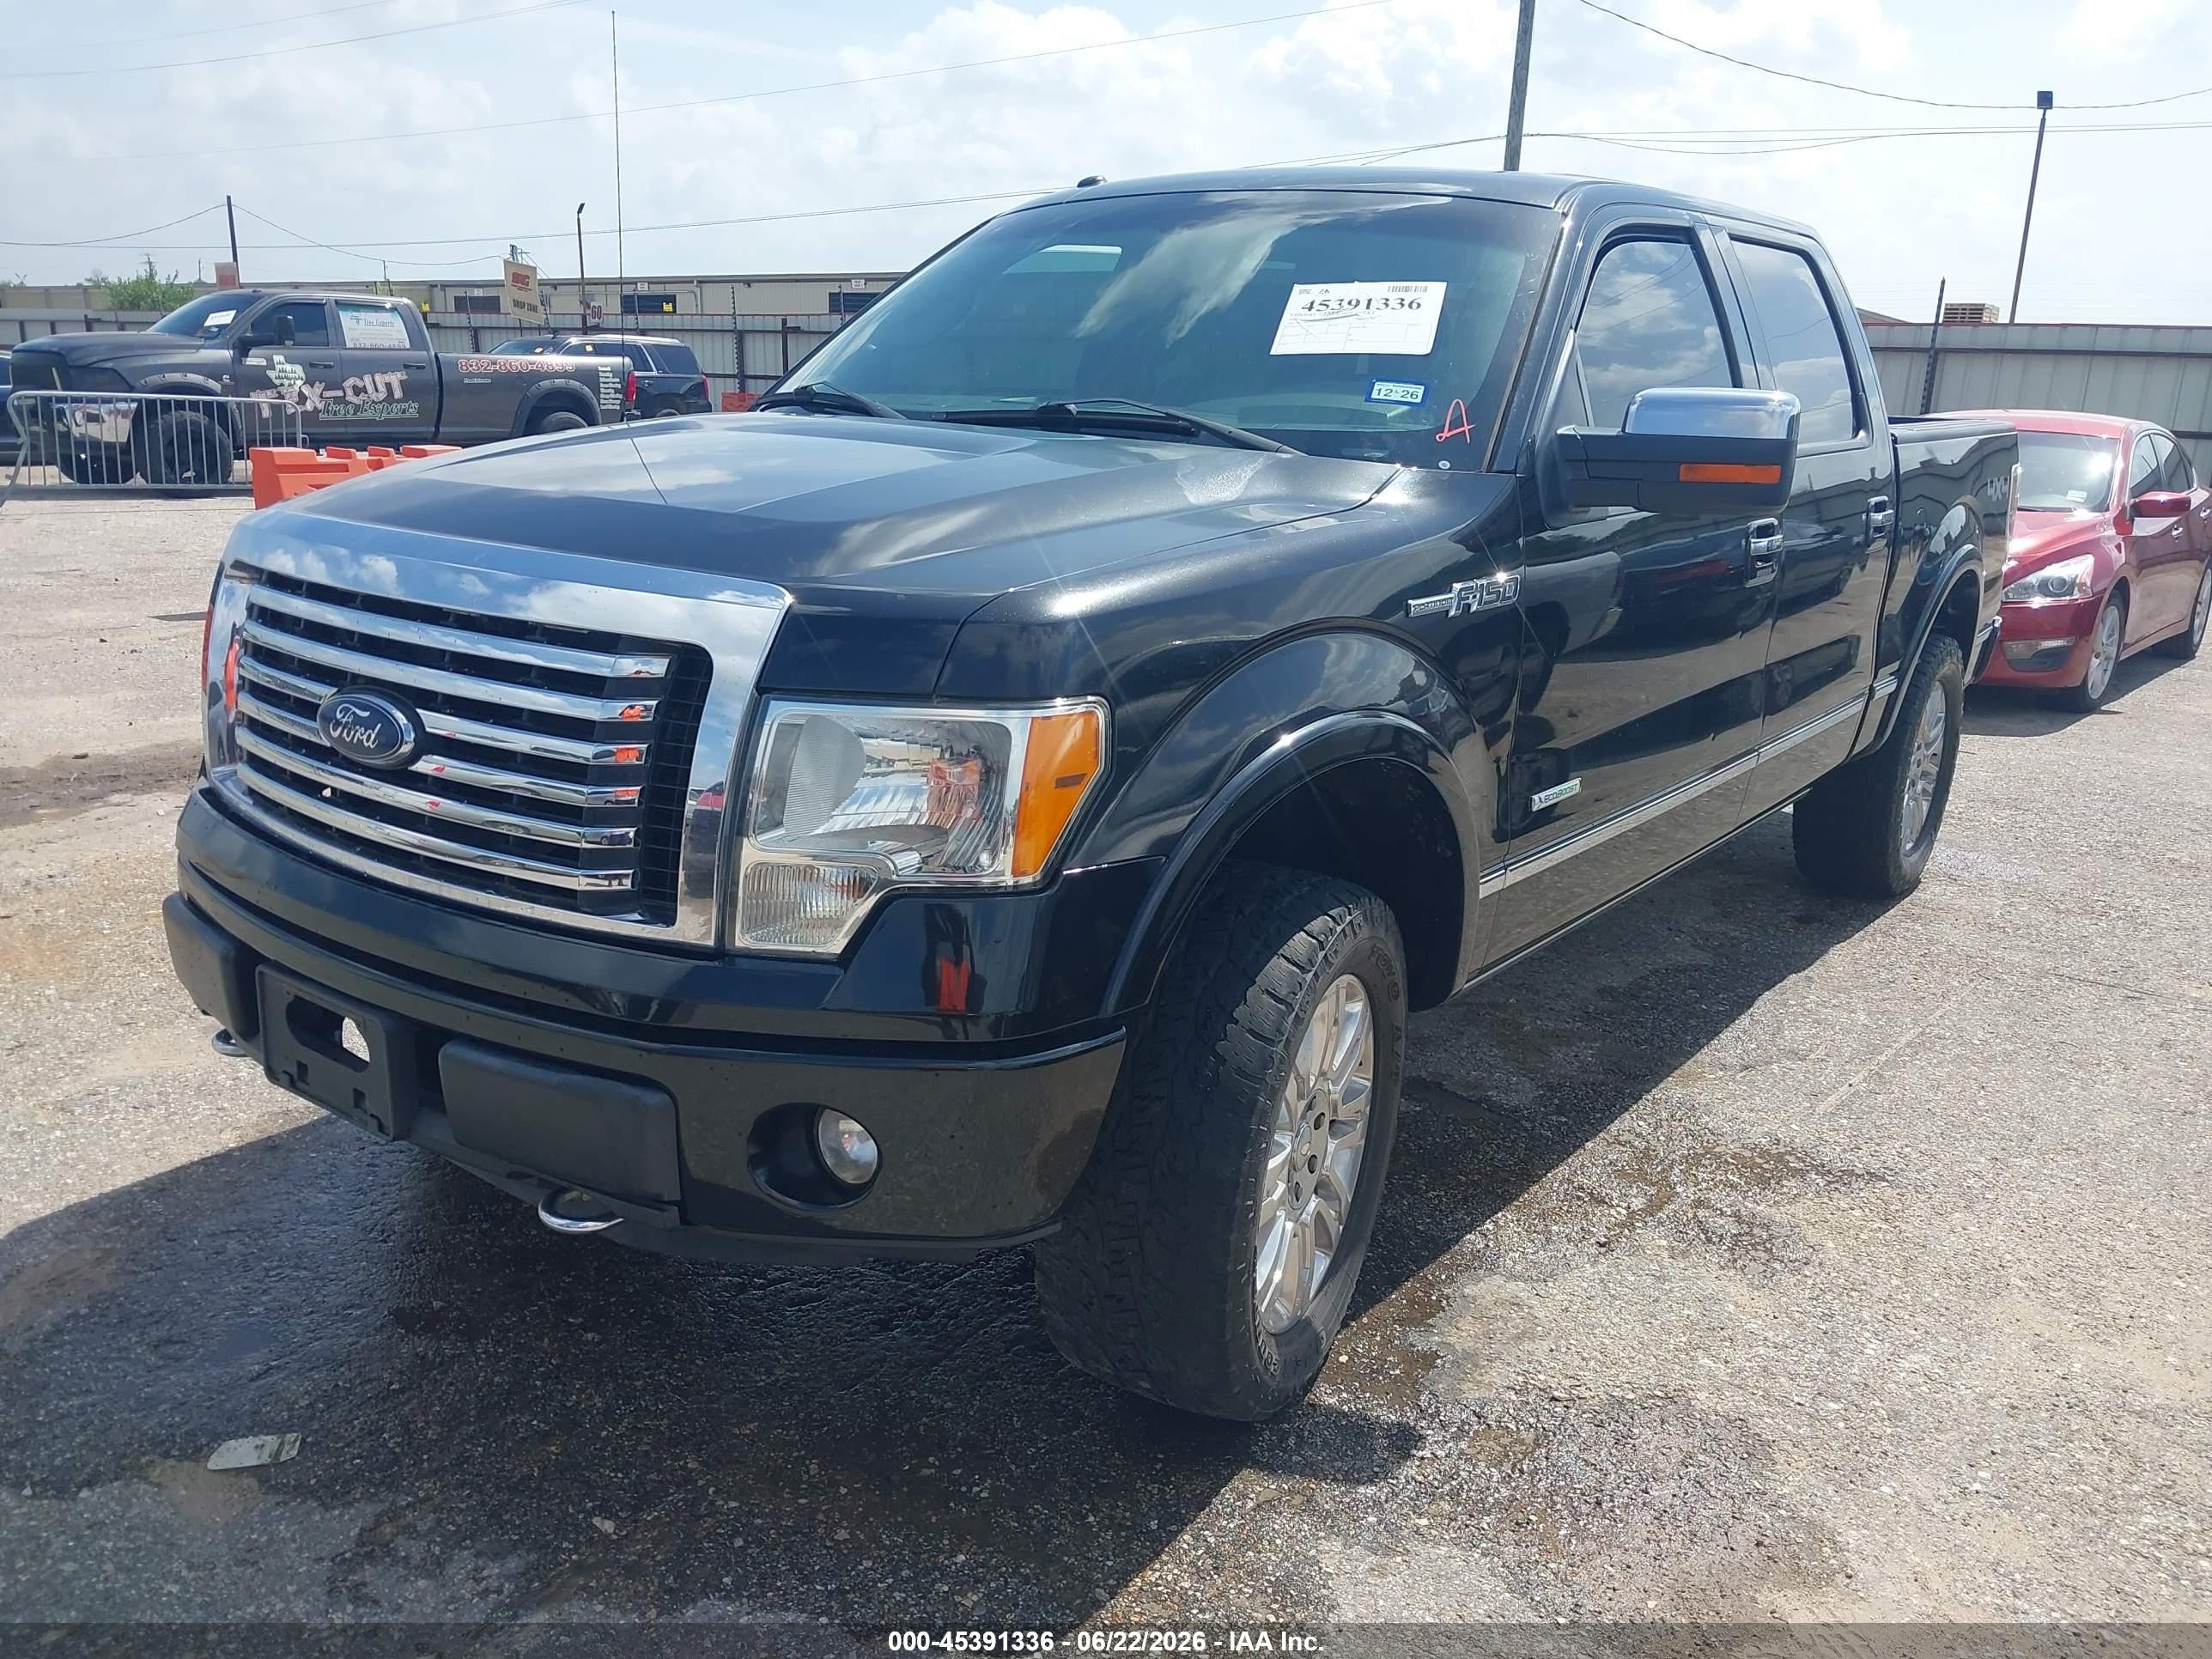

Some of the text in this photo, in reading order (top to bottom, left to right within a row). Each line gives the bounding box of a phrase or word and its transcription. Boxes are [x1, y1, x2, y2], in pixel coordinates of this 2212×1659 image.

[592, 305, 602, 320] 60
[1301, 297, 1423, 312] 45391336
[1400, 389, 1419, 400] 26
[319, 398, 420, 421] Tree Experts
[1436, 398, 1476, 444] A
[329, 703, 381, 750] Ford
